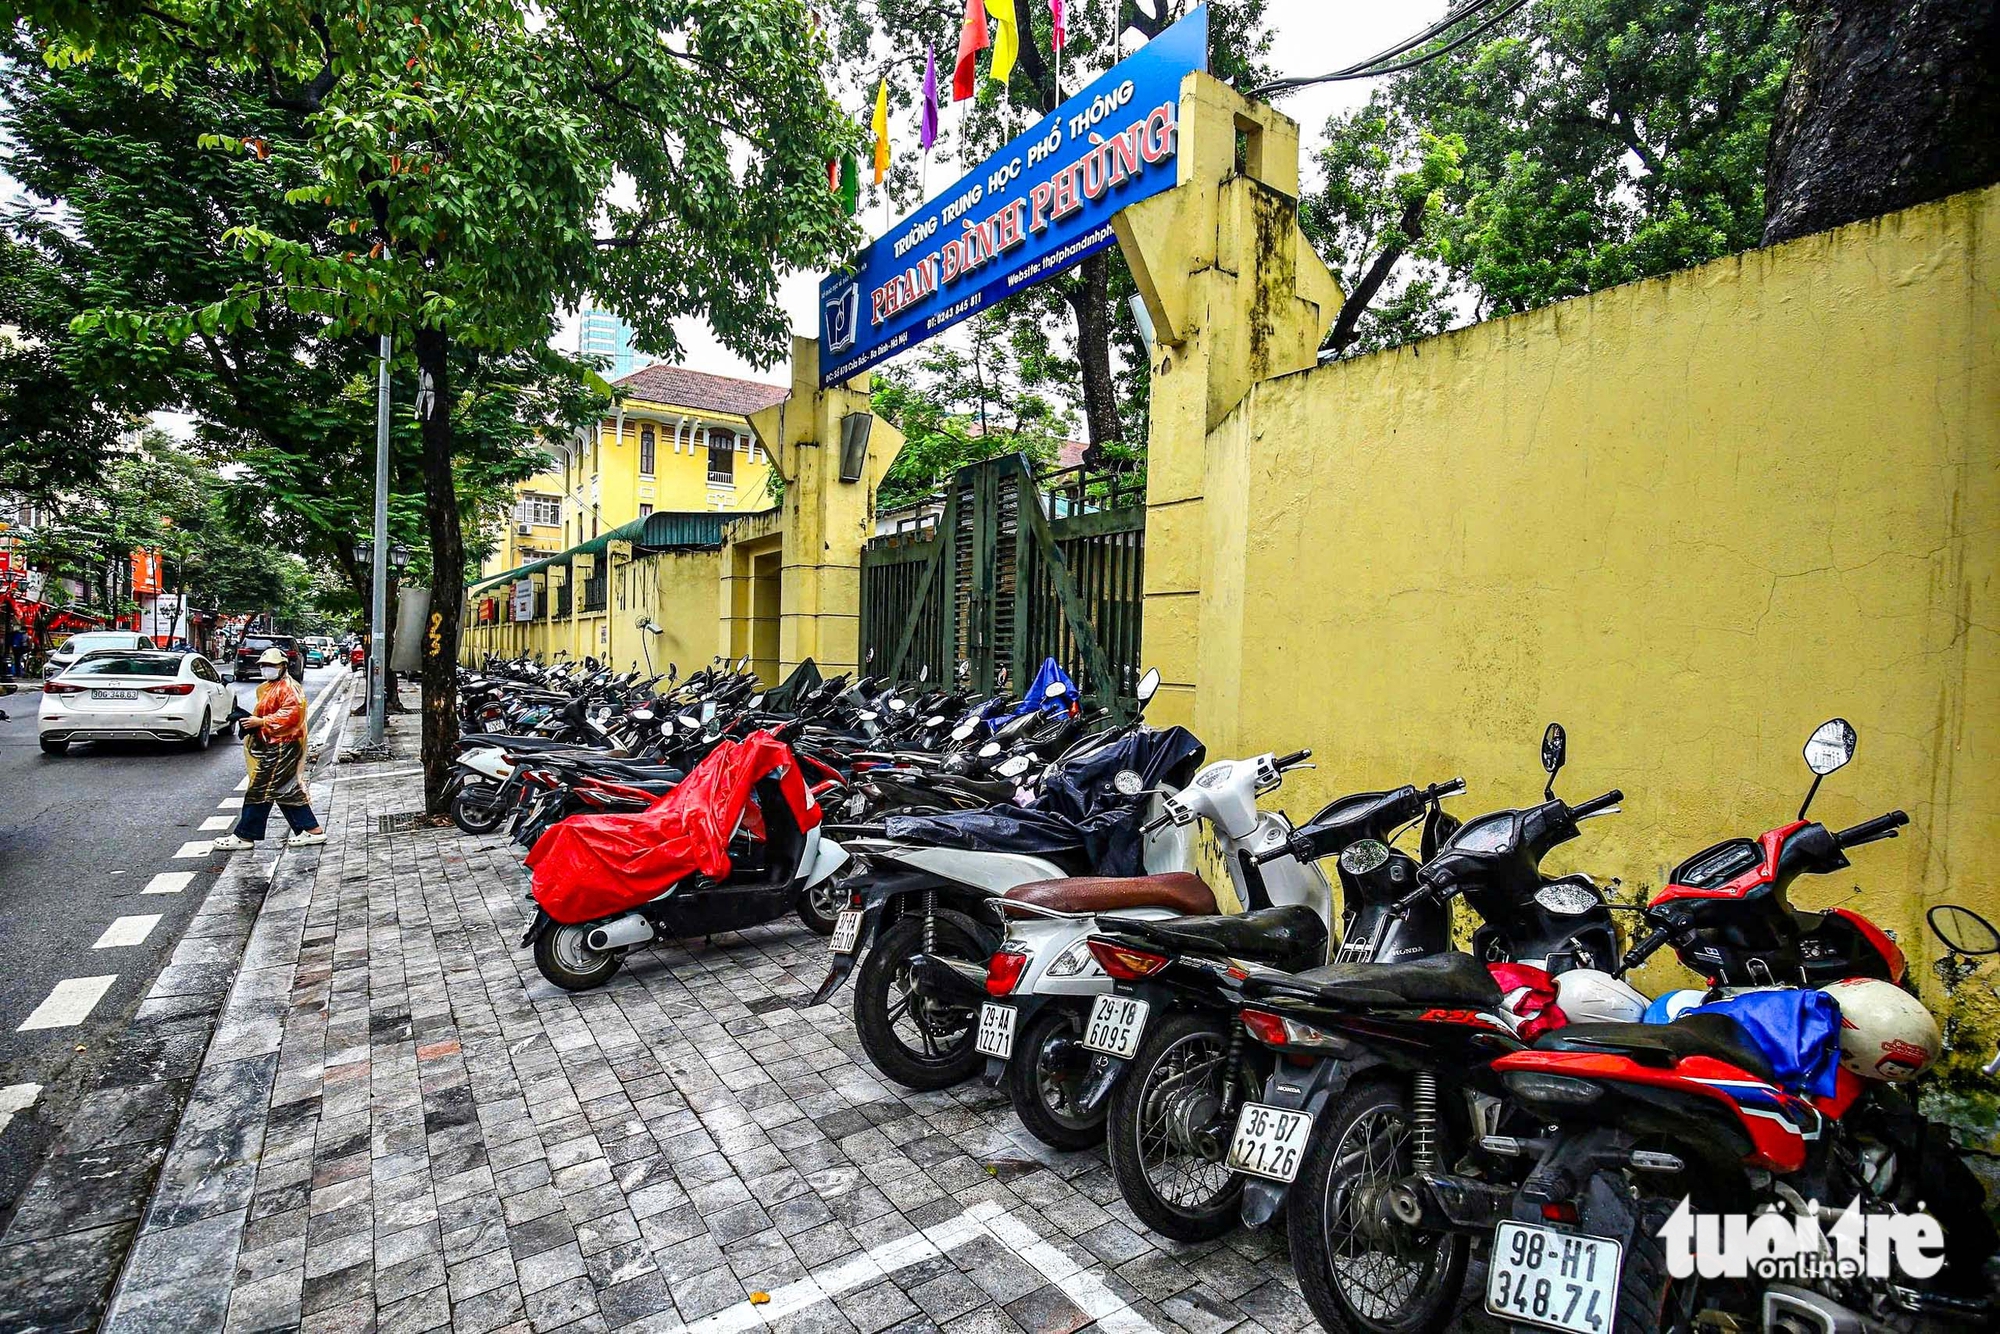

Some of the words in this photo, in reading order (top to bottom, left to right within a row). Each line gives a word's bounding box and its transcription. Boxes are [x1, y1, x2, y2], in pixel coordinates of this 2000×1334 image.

[941, 184, 983, 226] TRUNG
[988, 157, 1022, 195] HỌC
[1027, 116, 1062, 169] PHỔ
[1069, 79, 1135, 140] THÔNG
[871, 252, 938, 325] PHAN
[941, 198, 1025, 285] ĐÌNH
[1029, 101, 1176, 233] PHÙNG
[1007, 263, 1041, 287] Website:
[1042, 223, 1115, 270] thptphandinhph
[937, 307, 954, 325] 0243
[955, 299, 969, 315] 845
[970, 291, 982, 307] 811
[1392, 946, 1424, 956] HONDA
[983, 1006, 1011, 1031] 29-AA
[1096, 998, 1137, 1026] 29-Y8
[979, 1028, 1010, 1055] 122.71
[1089, 1022, 1131, 1051] 6095
[1276, 1085, 1302, 1094] HONDA
[1245, 1109, 1301, 1142] 36-B7
[1236, 1138, 1297, 1176] 121.26
[1509, 1230, 1598, 1282] 98-H1
[1494, 1270, 1603, 1332] 348.74
